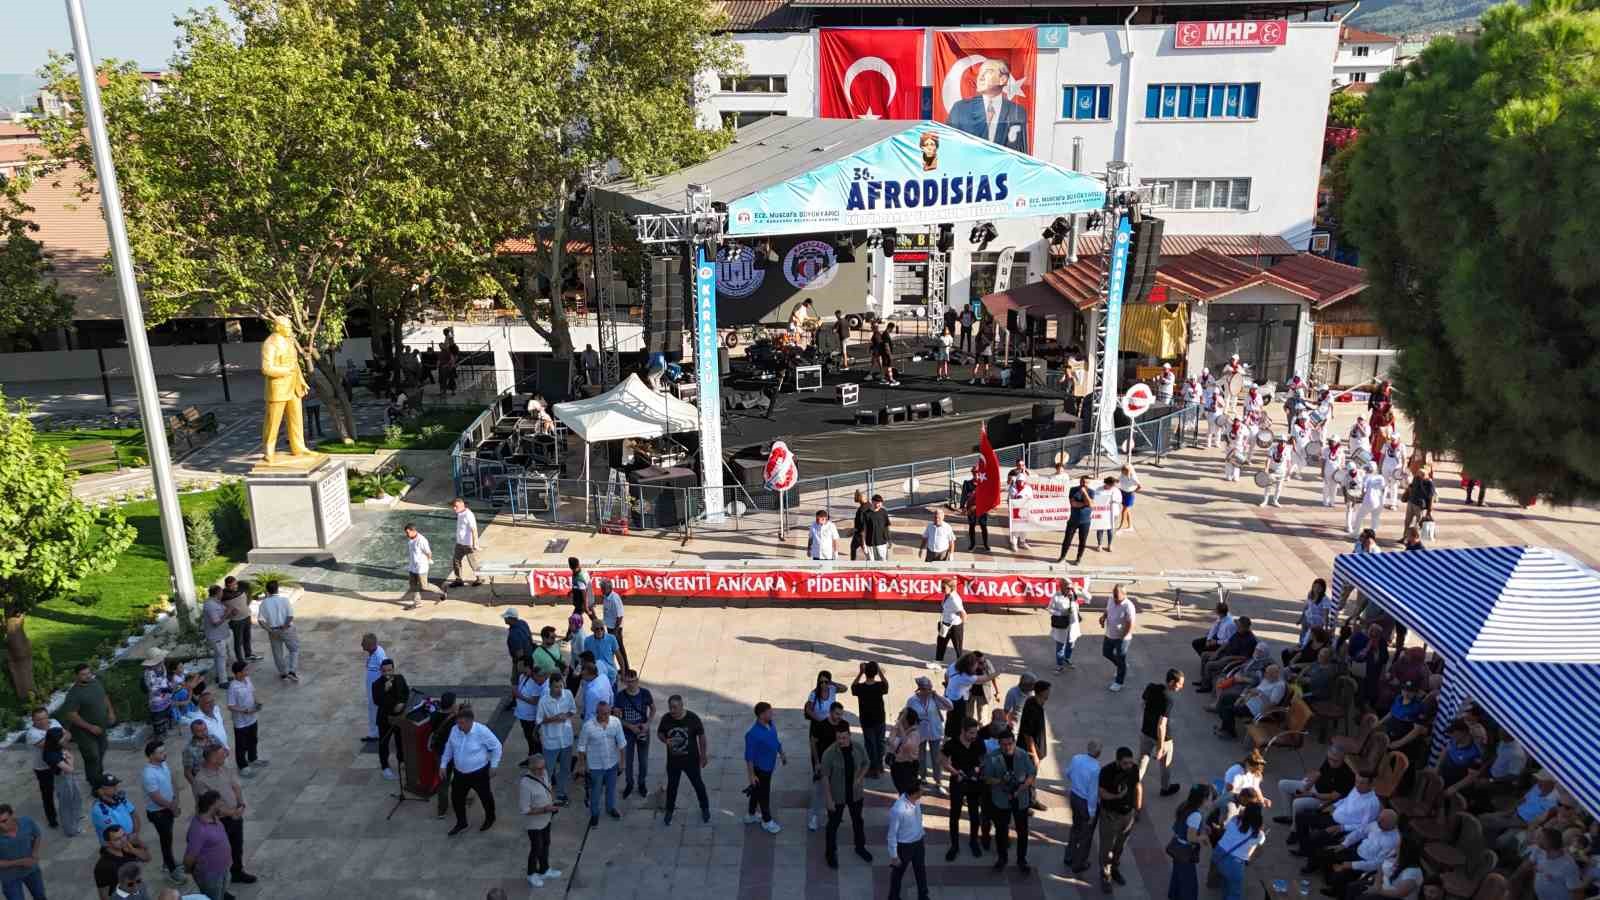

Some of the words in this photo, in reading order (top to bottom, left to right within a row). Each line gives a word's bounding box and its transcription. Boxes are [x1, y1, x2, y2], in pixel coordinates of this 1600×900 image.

[1206, 22, 1258, 41] MHP
[846, 171, 1009, 211] AFRODİSİAS
[701, 284, 713, 384] KARACASU
[633, 572, 711, 593] BAŞKENTİ
[716, 575, 787, 592] ANKARA
[807, 572, 872, 593] PİDENİN
[878, 576, 957, 596] BAŞKENİ
[963, 580, 1056, 598] KARACASU
